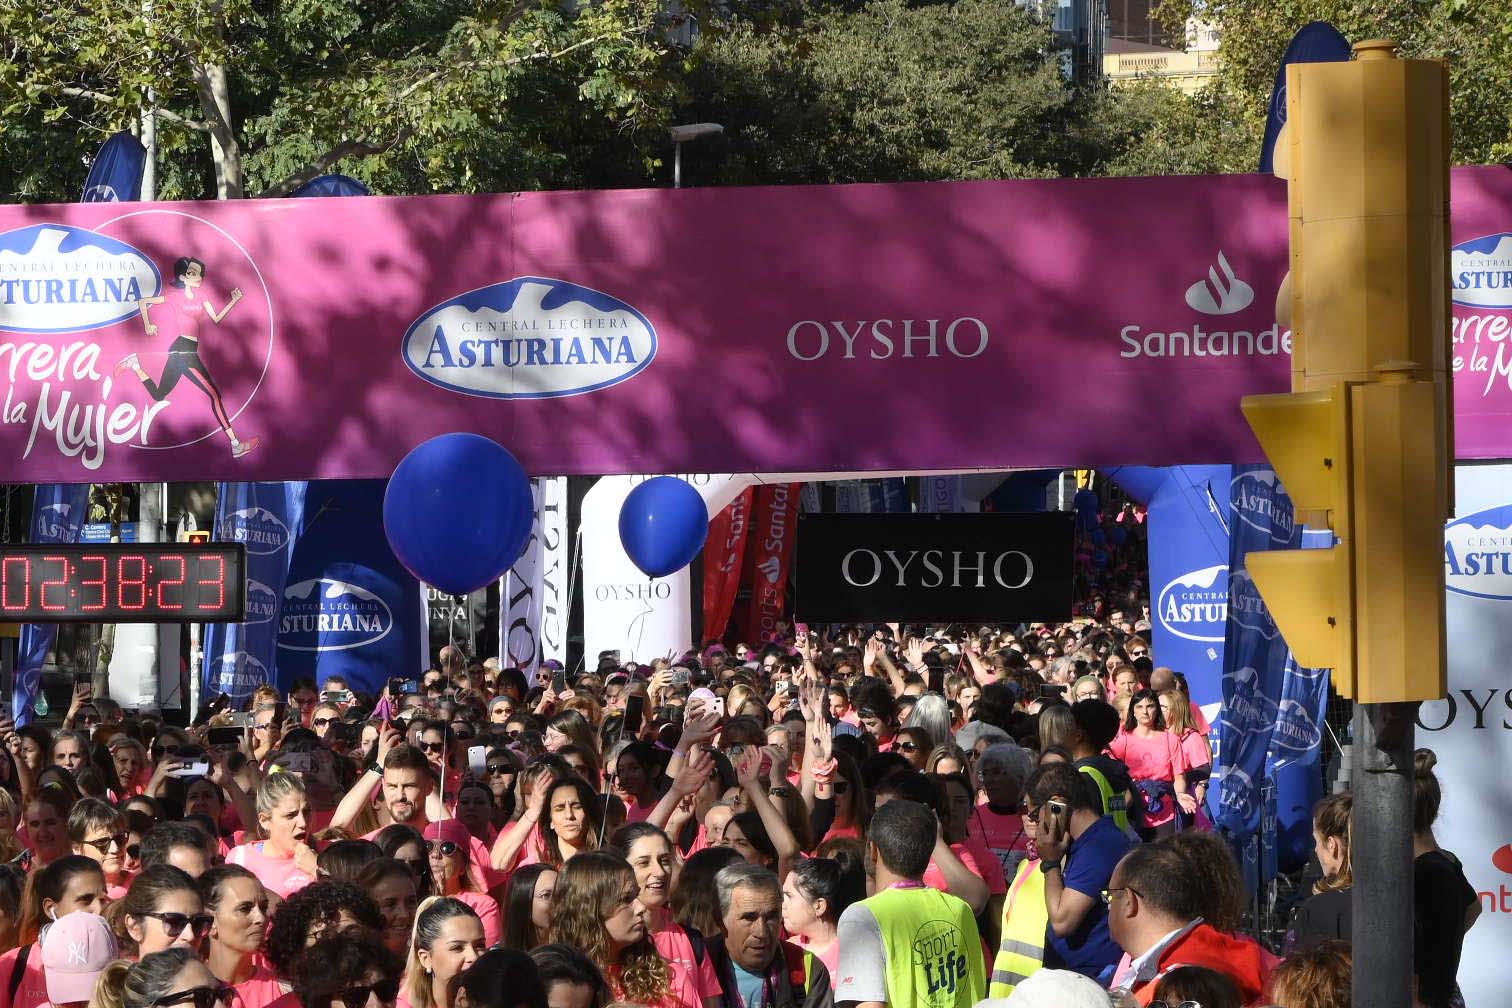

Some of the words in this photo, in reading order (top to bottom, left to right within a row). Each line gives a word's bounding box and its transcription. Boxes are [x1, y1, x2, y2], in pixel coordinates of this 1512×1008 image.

[462, 317, 539, 333] CENTRAL
[547, 316, 630, 331] LECHERA
[787, 316, 990, 361] OYSHO
[1119, 323, 1292, 359] Santande
[422, 322, 639, 370] ASTURIANA
[2, 383, 28, 424] la
[22, 374, 172, 470] Mujer
[2, 555, 225, 609] 02:38:23
[841, 548, 1035, 589] OYSHO
[596, 582, 672, 602] OYSHO
[278, 614, 383, 634] STURIANA
[914, 926, 958, 966] Sport
[924, 950, 966, 995] Life
